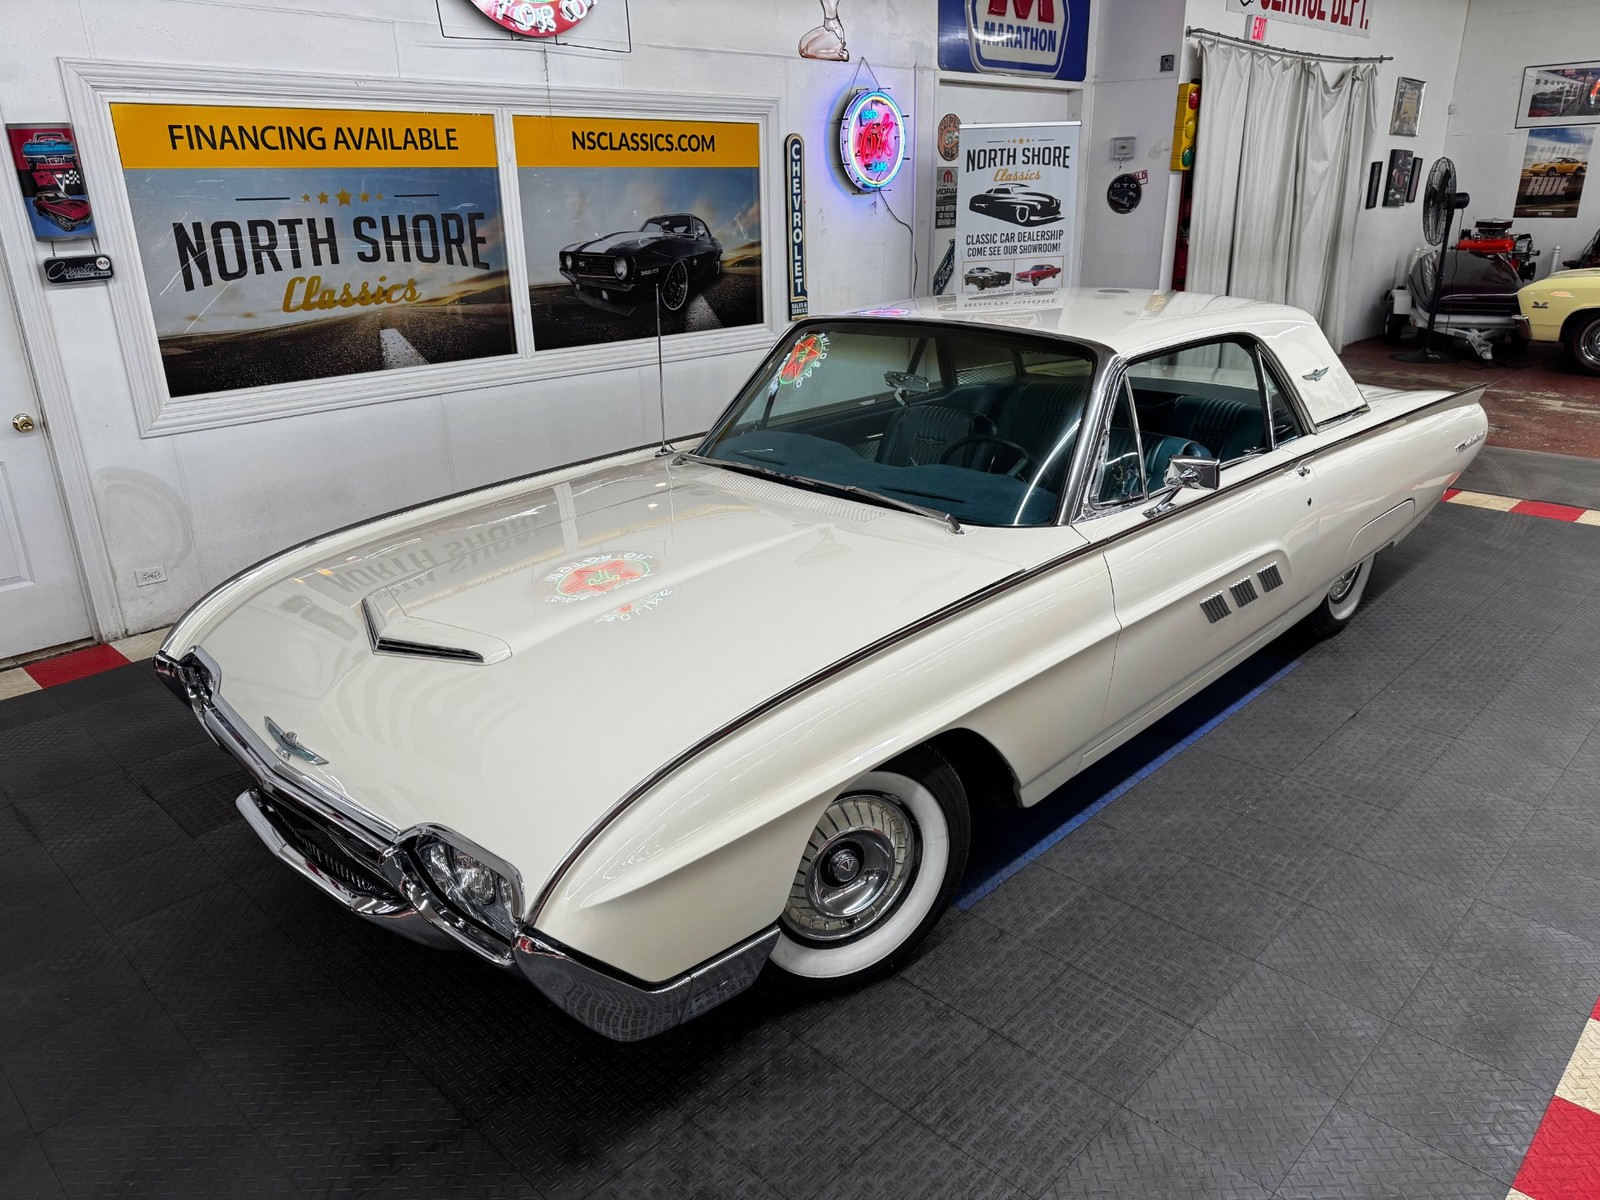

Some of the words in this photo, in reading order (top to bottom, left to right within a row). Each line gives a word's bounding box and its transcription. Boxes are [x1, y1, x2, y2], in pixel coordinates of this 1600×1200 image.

[983, 21, 1056, 52] MARATHON
[168, 124, 327, 150] FINANCING
[333, 126, 459, 150] AVAILABLE
[571, 131, 716, 152] NSCLASSICS.COM
[966, 147, 1016, 173] NORTH
[1021, 145, 1070, 169] SHORE
[993, 168, 1041, 182] Classics
[1525, 176, 1569, 196] RIDE
[792, 143, 805, 293] CHEVROLET
[966, 233, 998, 246] CLASSIC
[1000, 232, 1015, 244] CAR
[1017, 229, 1064, 242] DEALERSHIP
[172, 217, 340, 292] NORTH
[352, 212, 490, 270] SHORE
[967, 246, 987, 257] COME
[989, 246, 1002, 256] SEE
[1003, 244, 1018, 255] OUR
[1019, 243, 1061, 254] SHOWROOM!
[47, 261, 99, 280] Corvette
[282, 275, 422, 313] Classics
